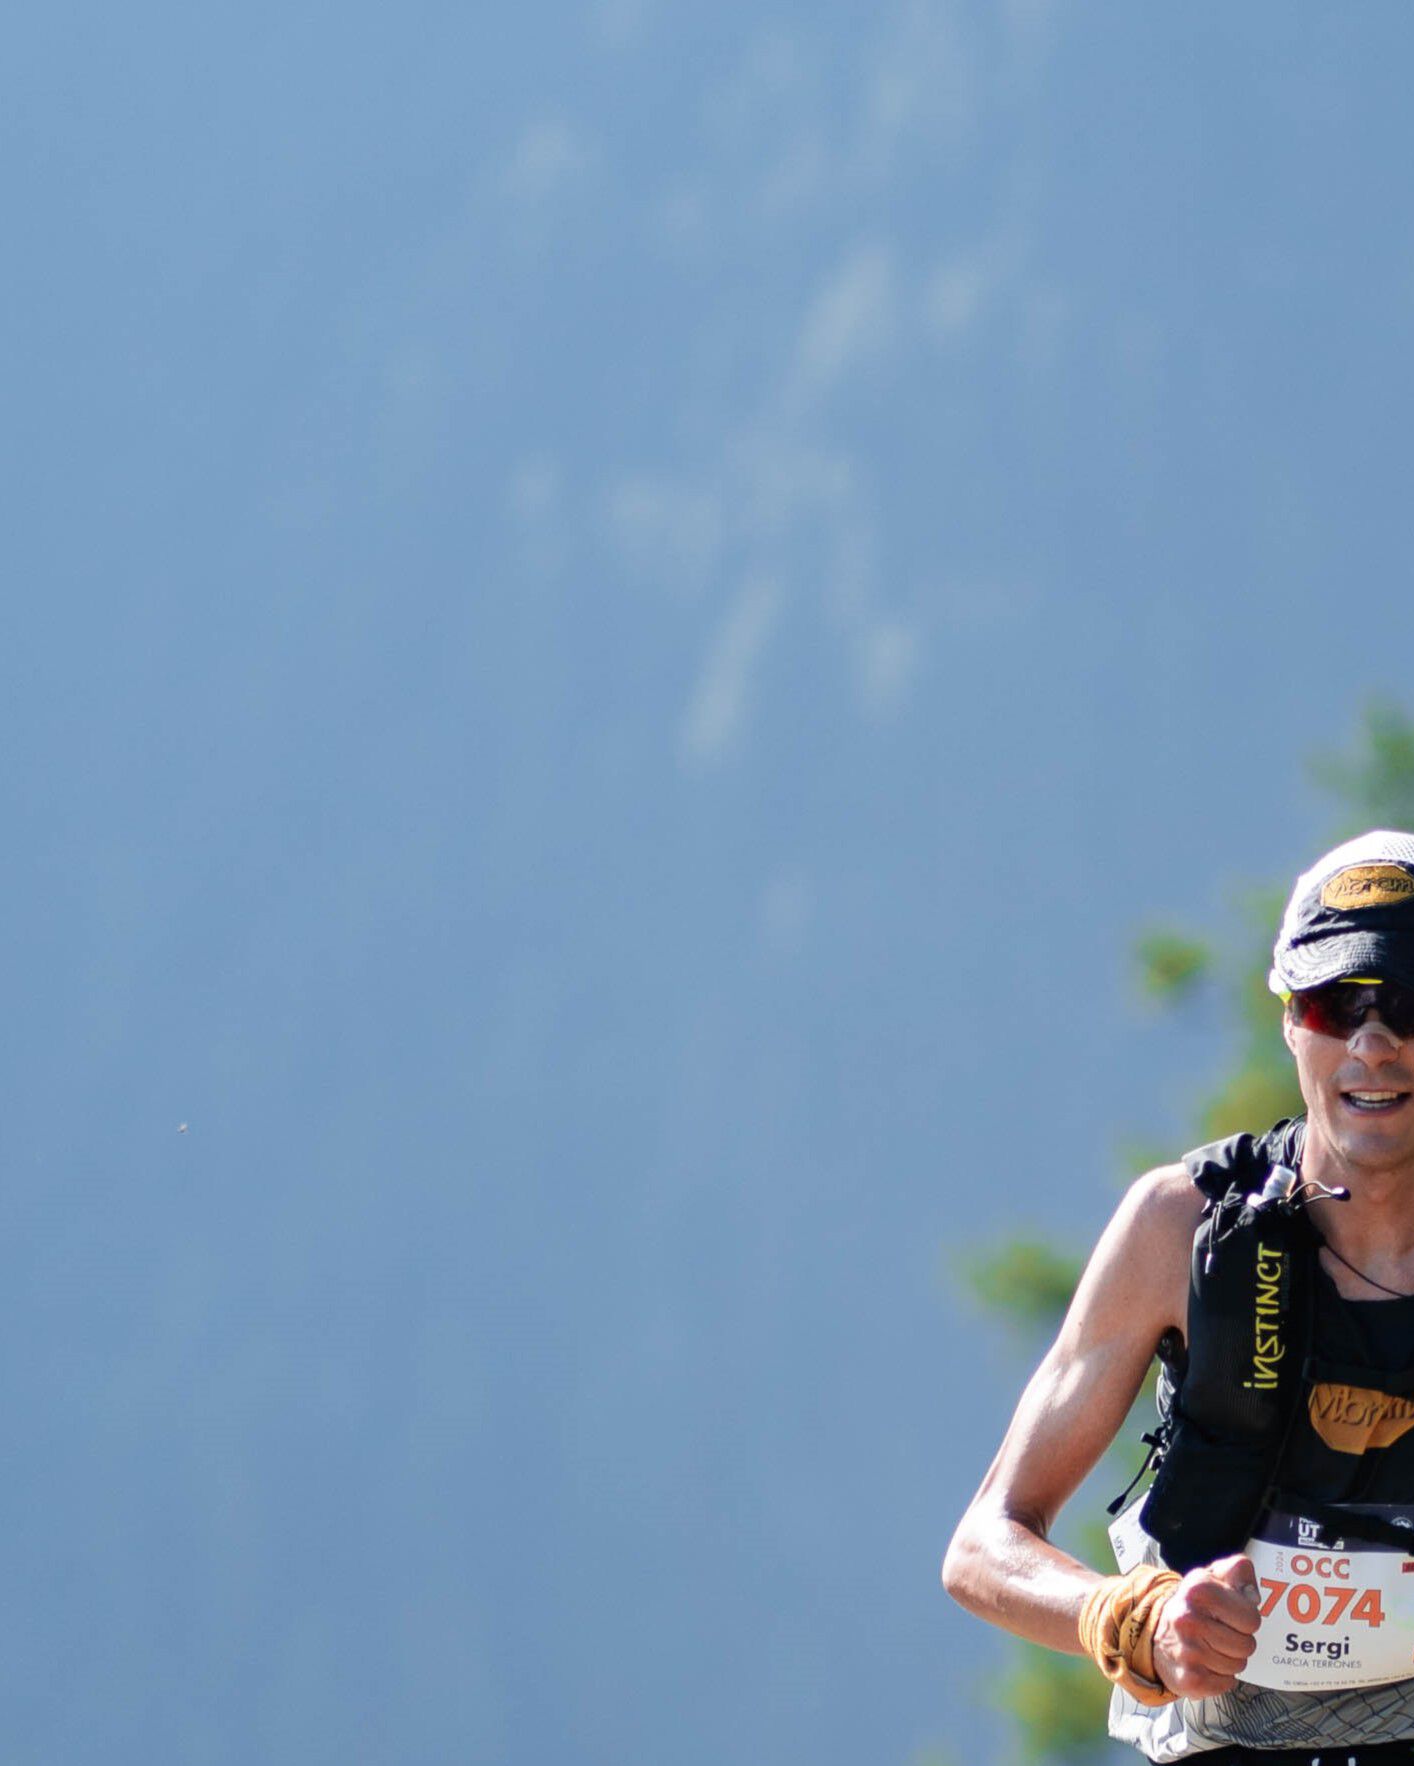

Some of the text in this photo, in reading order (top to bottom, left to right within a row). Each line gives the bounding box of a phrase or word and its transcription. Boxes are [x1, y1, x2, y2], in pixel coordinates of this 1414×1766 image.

[1290, 1554, 1350, 1580] OCC
[1259, 1577, 1385, 1628] 7074
[1285, 1634, 1350, 1660] Sergi
[1312, 1659, 1362, 1669] TERRONES
